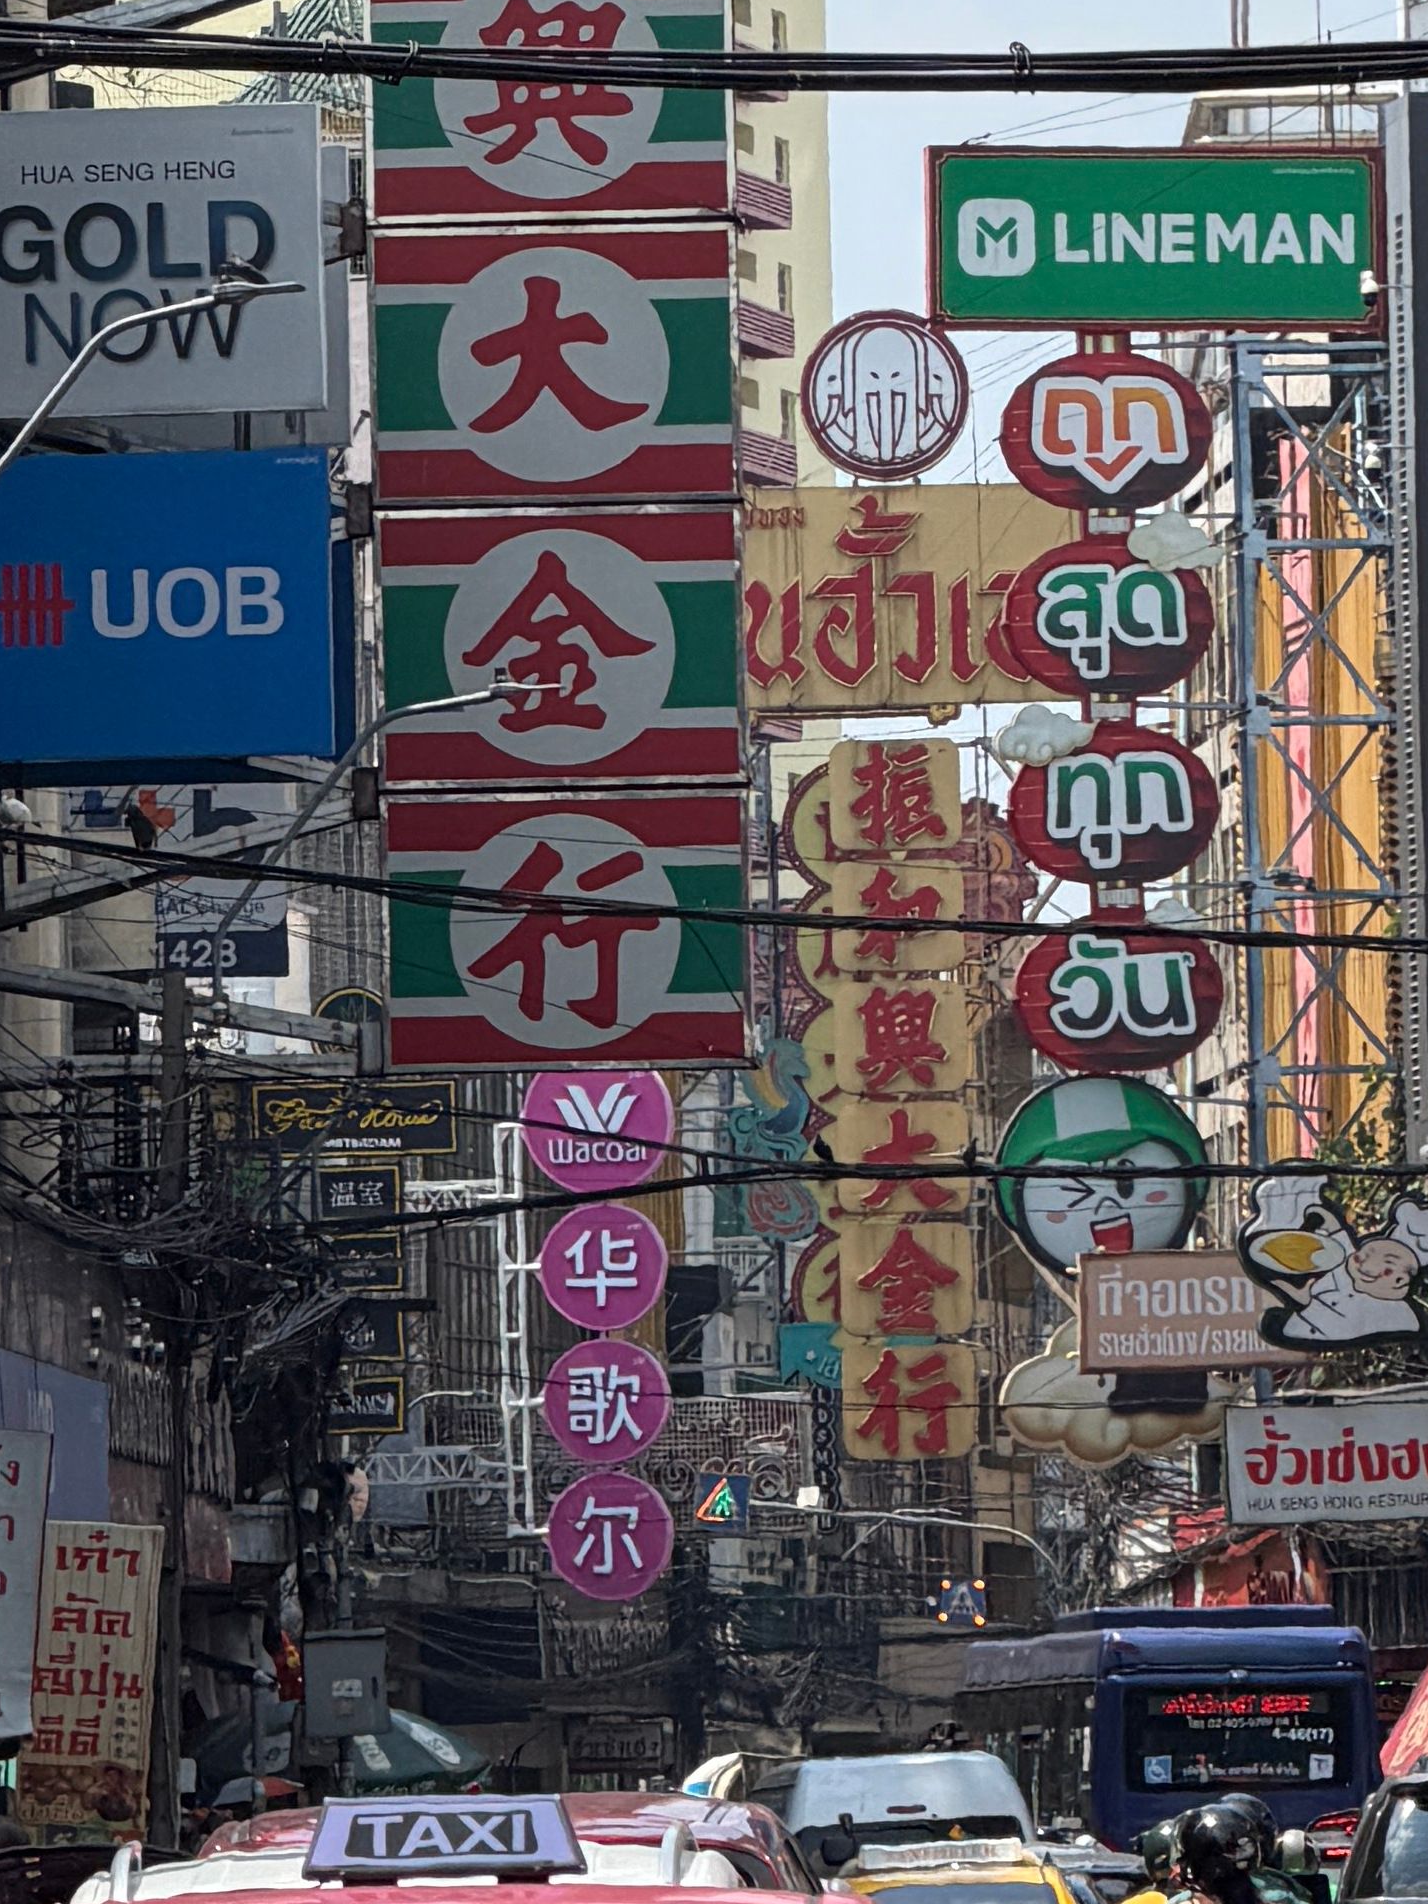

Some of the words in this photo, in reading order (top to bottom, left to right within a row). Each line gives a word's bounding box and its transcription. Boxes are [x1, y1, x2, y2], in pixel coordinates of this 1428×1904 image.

[21, 164, 74, 185] HUA
[84, 163, 154, 183] SENG
[164, 160, 236, 181] HENG
[25, 288, 244, 366] NOW
[90, 566, 285, 639] UOB
[1041, 567, 1183, 676] สุด
[1052, 755, 1189, 866] ทุก
[158, 939, 238, 969] 1428
[1053, 935, 1192, 1037] วัน
[564, 1230, 643, 1574] 华歌尔
[1247, 1496, 1275, 1513] HUA
[1281, 1494, 1317, 1512] SENG
[1323, 1493, 1363, 1511] HONG
[357, 1814, 527, 1856] TAXI
